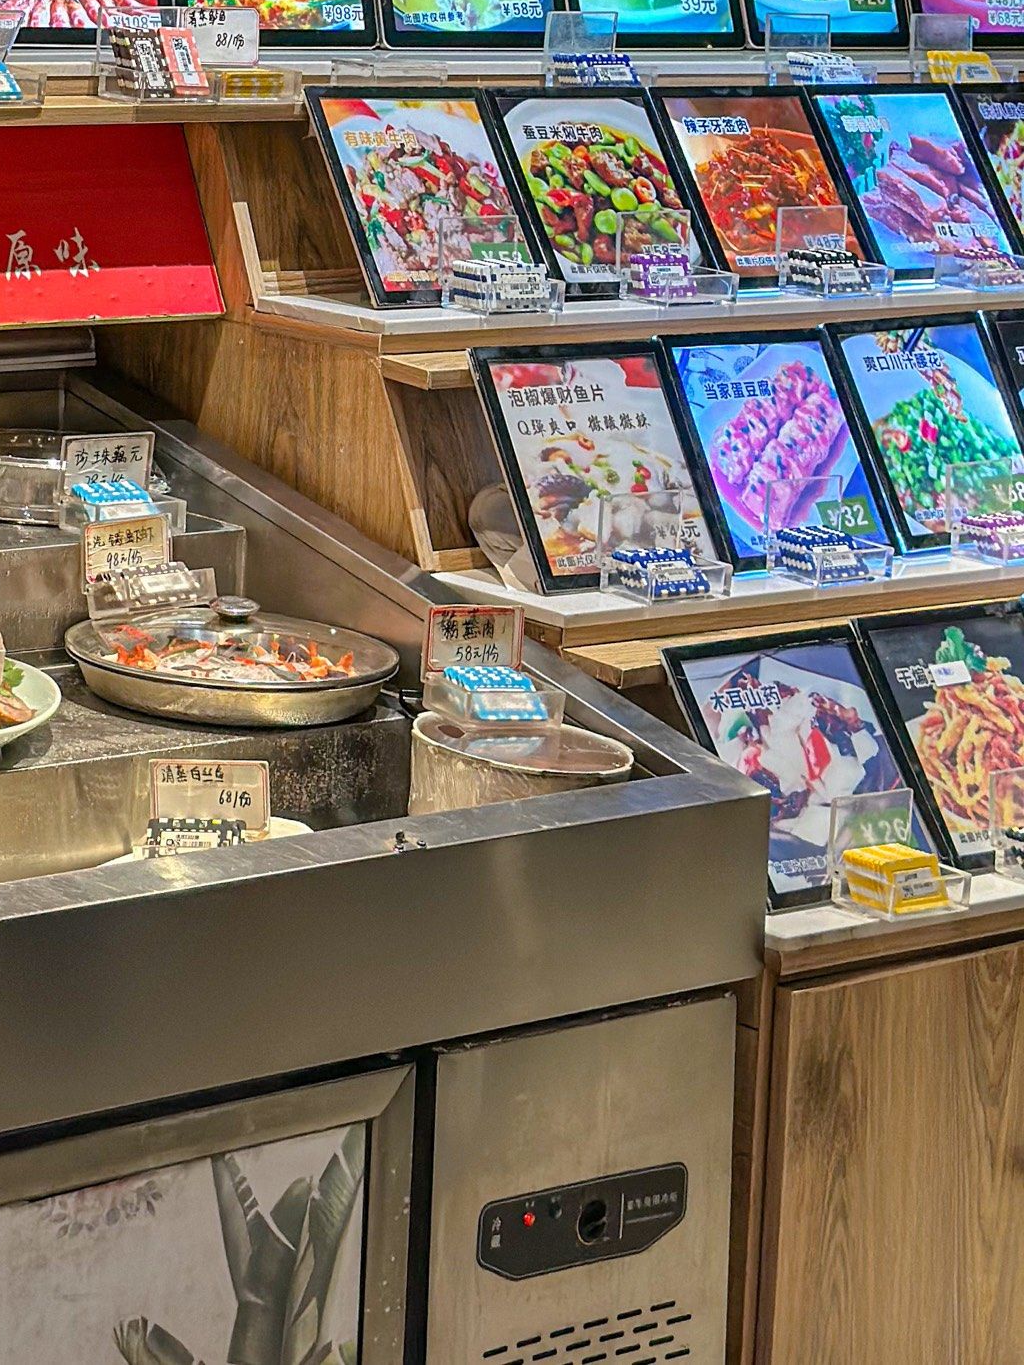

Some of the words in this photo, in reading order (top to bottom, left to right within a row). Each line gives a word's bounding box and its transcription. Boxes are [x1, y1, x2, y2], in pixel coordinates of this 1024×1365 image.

[322, 4, 364, 22] ¥98元
[404, 11, 464, 24] 此图片仅供参考
[502, 0, 543, 17] ¥58元
[523, 125, 603, 142] 蚕豆米焖牛肉
[682, 116, 751, 134] 辣子牙签肉
[863, 351, 943, 372] 爽口川汁腰花
[508, 385, 605, 408] 泡椒爆财鱼片
[704, 380, 773, 401] 当家蛋豆腐
[107, 549, 142, 568] 98元/份
[456, 643, 499, 663] 58元/份
[710, 685, 781, 712] 木耳山药
[219, 789, 251, 808] 68/份
